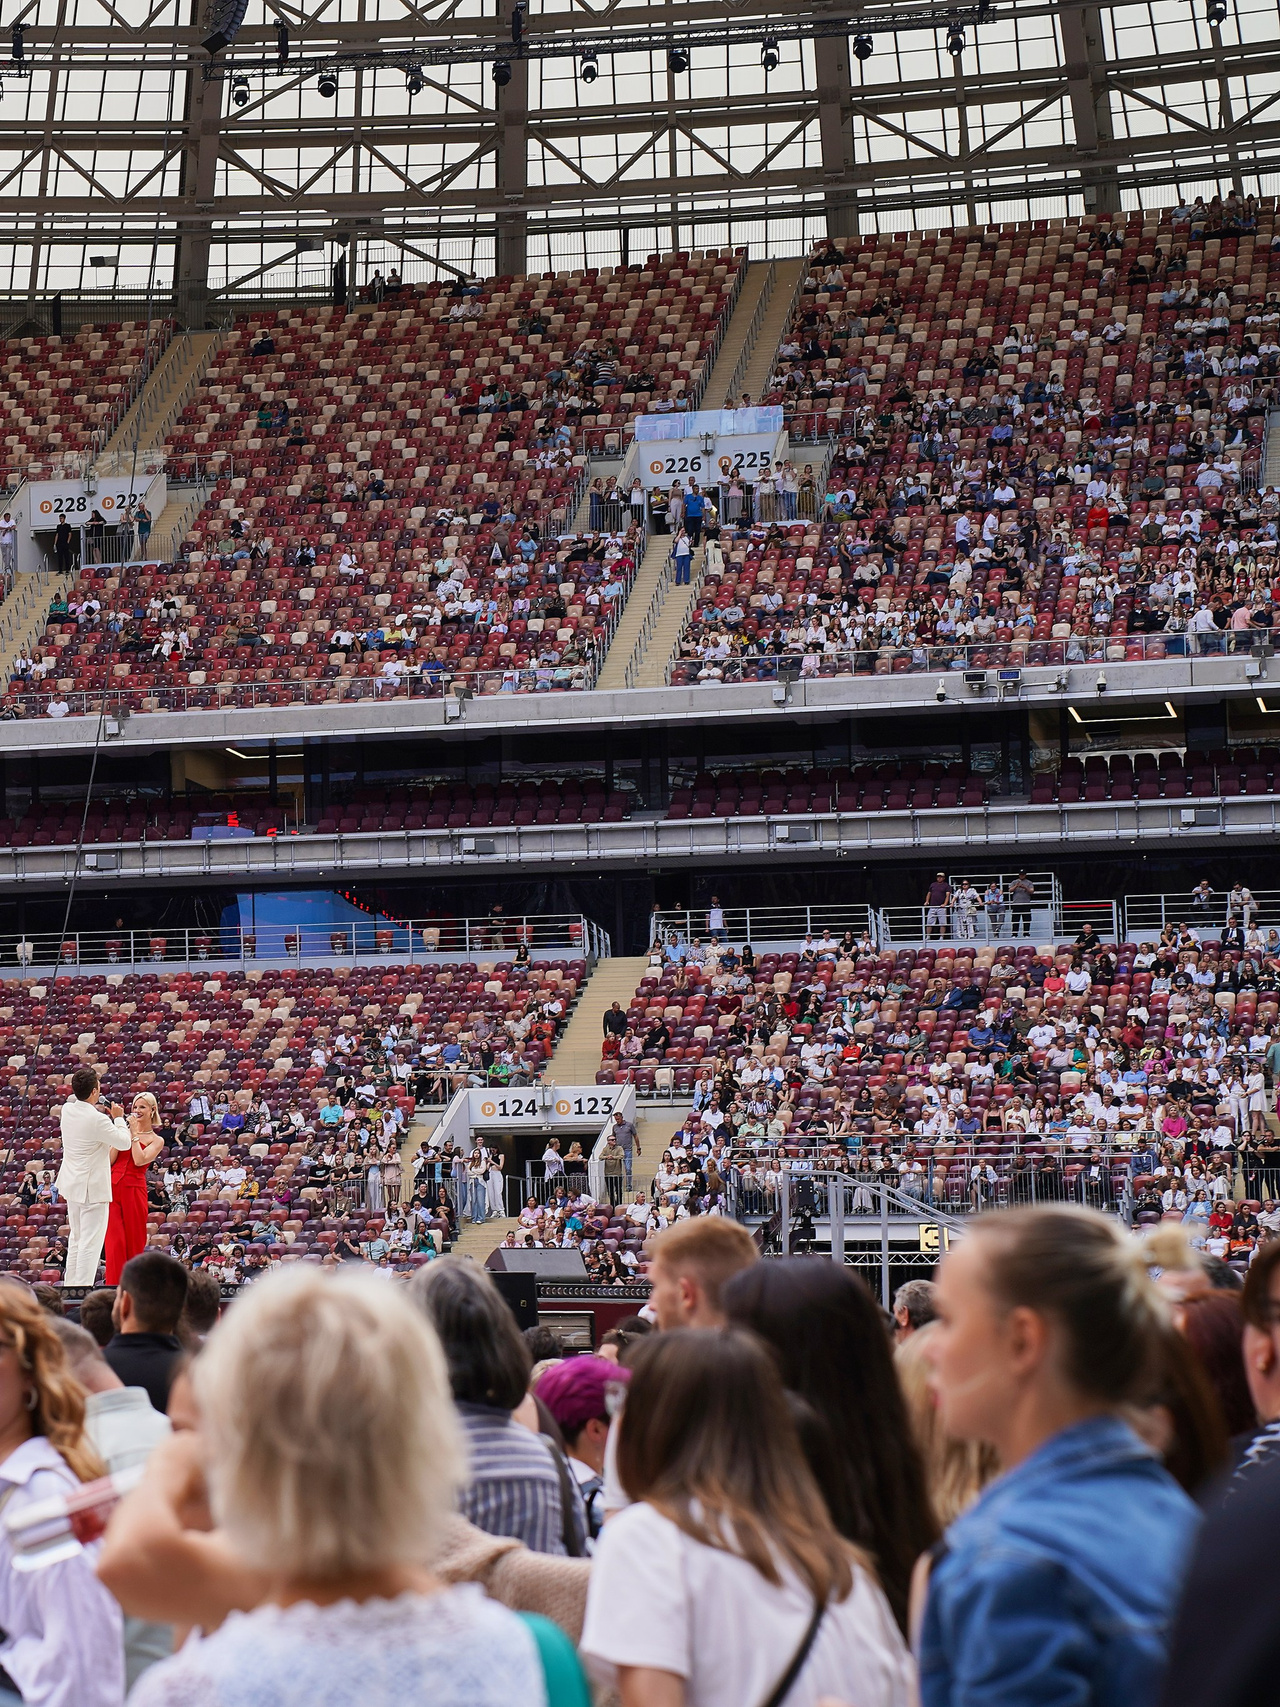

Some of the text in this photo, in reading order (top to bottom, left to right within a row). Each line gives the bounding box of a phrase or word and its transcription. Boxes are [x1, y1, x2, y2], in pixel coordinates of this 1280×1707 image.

[665, 456, 702, 474] 226
[734, 451, 771, 469] 225
[53, 496, 87, 513] 228
[498, 1099, 538, 1117] 124
[574, 1097, 613, 1115] 123
